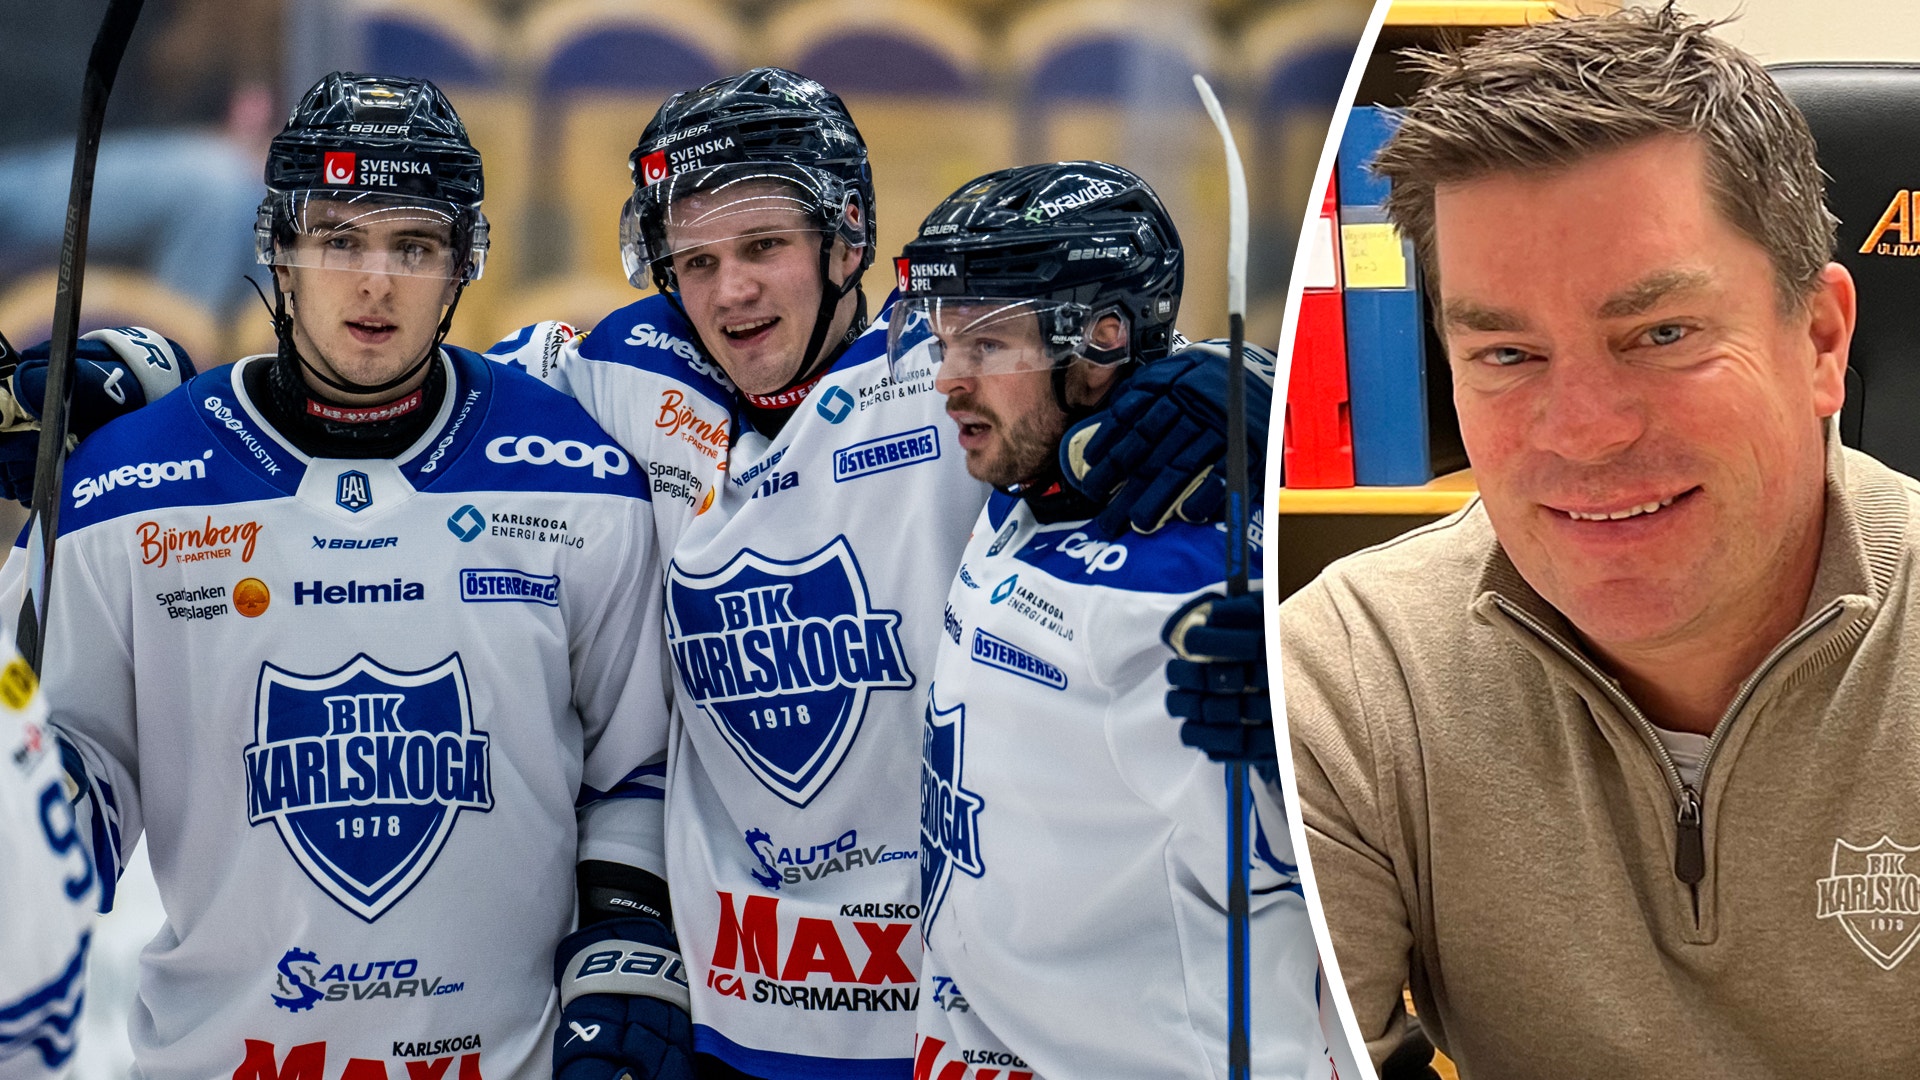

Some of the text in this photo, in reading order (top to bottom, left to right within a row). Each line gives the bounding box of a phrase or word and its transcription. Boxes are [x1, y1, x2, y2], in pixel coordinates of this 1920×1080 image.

[349, 124, 410, 134] BAUER
[656, 125, 710, 147] BAUER
[670, 136, 735, 165] SVENSKA
[360, 159, 432, 175] SVENSKA
[673, 159, 706, 174] SPEL
[360, 174, 397, 187] SPEL
[1039, 178, 1113, 218] bravida
[923, 223, 959, 236] BAUER
[1067, 246, 1131, 261] BAUER
[911, 263, 957, 278] SVENSKA
[911, 279, 932, 291] SPEL
[759, 381, 818, 406] SYSTEM
[907, 380, 935, 396] MILJ
[485, 435, 630, 480] coop
[839, 434, 933, 474] ÖSTERBERGS
[72, 459, 206, 508] Swegon
[492, 513, 567, 530] KARLSKOGA
[136, 515, 263, 568] Björnberg
[328, 537, 398, 549] BAUER
[492, 526, 584, 549] ENERGI & MILJÖ
[294, 578, 424, 605] Helmia
[466, 573, 557, 601] ÖSTERBERG
[728, 586, 793, 631] BIK
[1016, 586, 1064, 621] KARLSKOGA
[671, 619, 907, 702] KARLSKOGA
[974, 633, 1063, 683] ÖSTERBERGS
[328, 698, 402, 733] BIK
[750, 705, 811, 730] 1978
[246, 735, 488, 817] KARLSKOGA
[336, 816, 400, 839] 1978
[777, 829, 857, 866] AUTO
[1866, 853, 1905, 876] BIK
[610, 897, 661, 918] BAUER
[1817, 875, 1920, 917] KARLSKO
[840, 903, 920, 919] KARLSKO
[711, 890, 917, 985] MAX
[319, 959, 418, 982] AUTO
[574, 951, 689, 988] BAU
[707, 969, 747, 1000] ICA
[392, 1034, 482, 1057] KARLSKOGA
